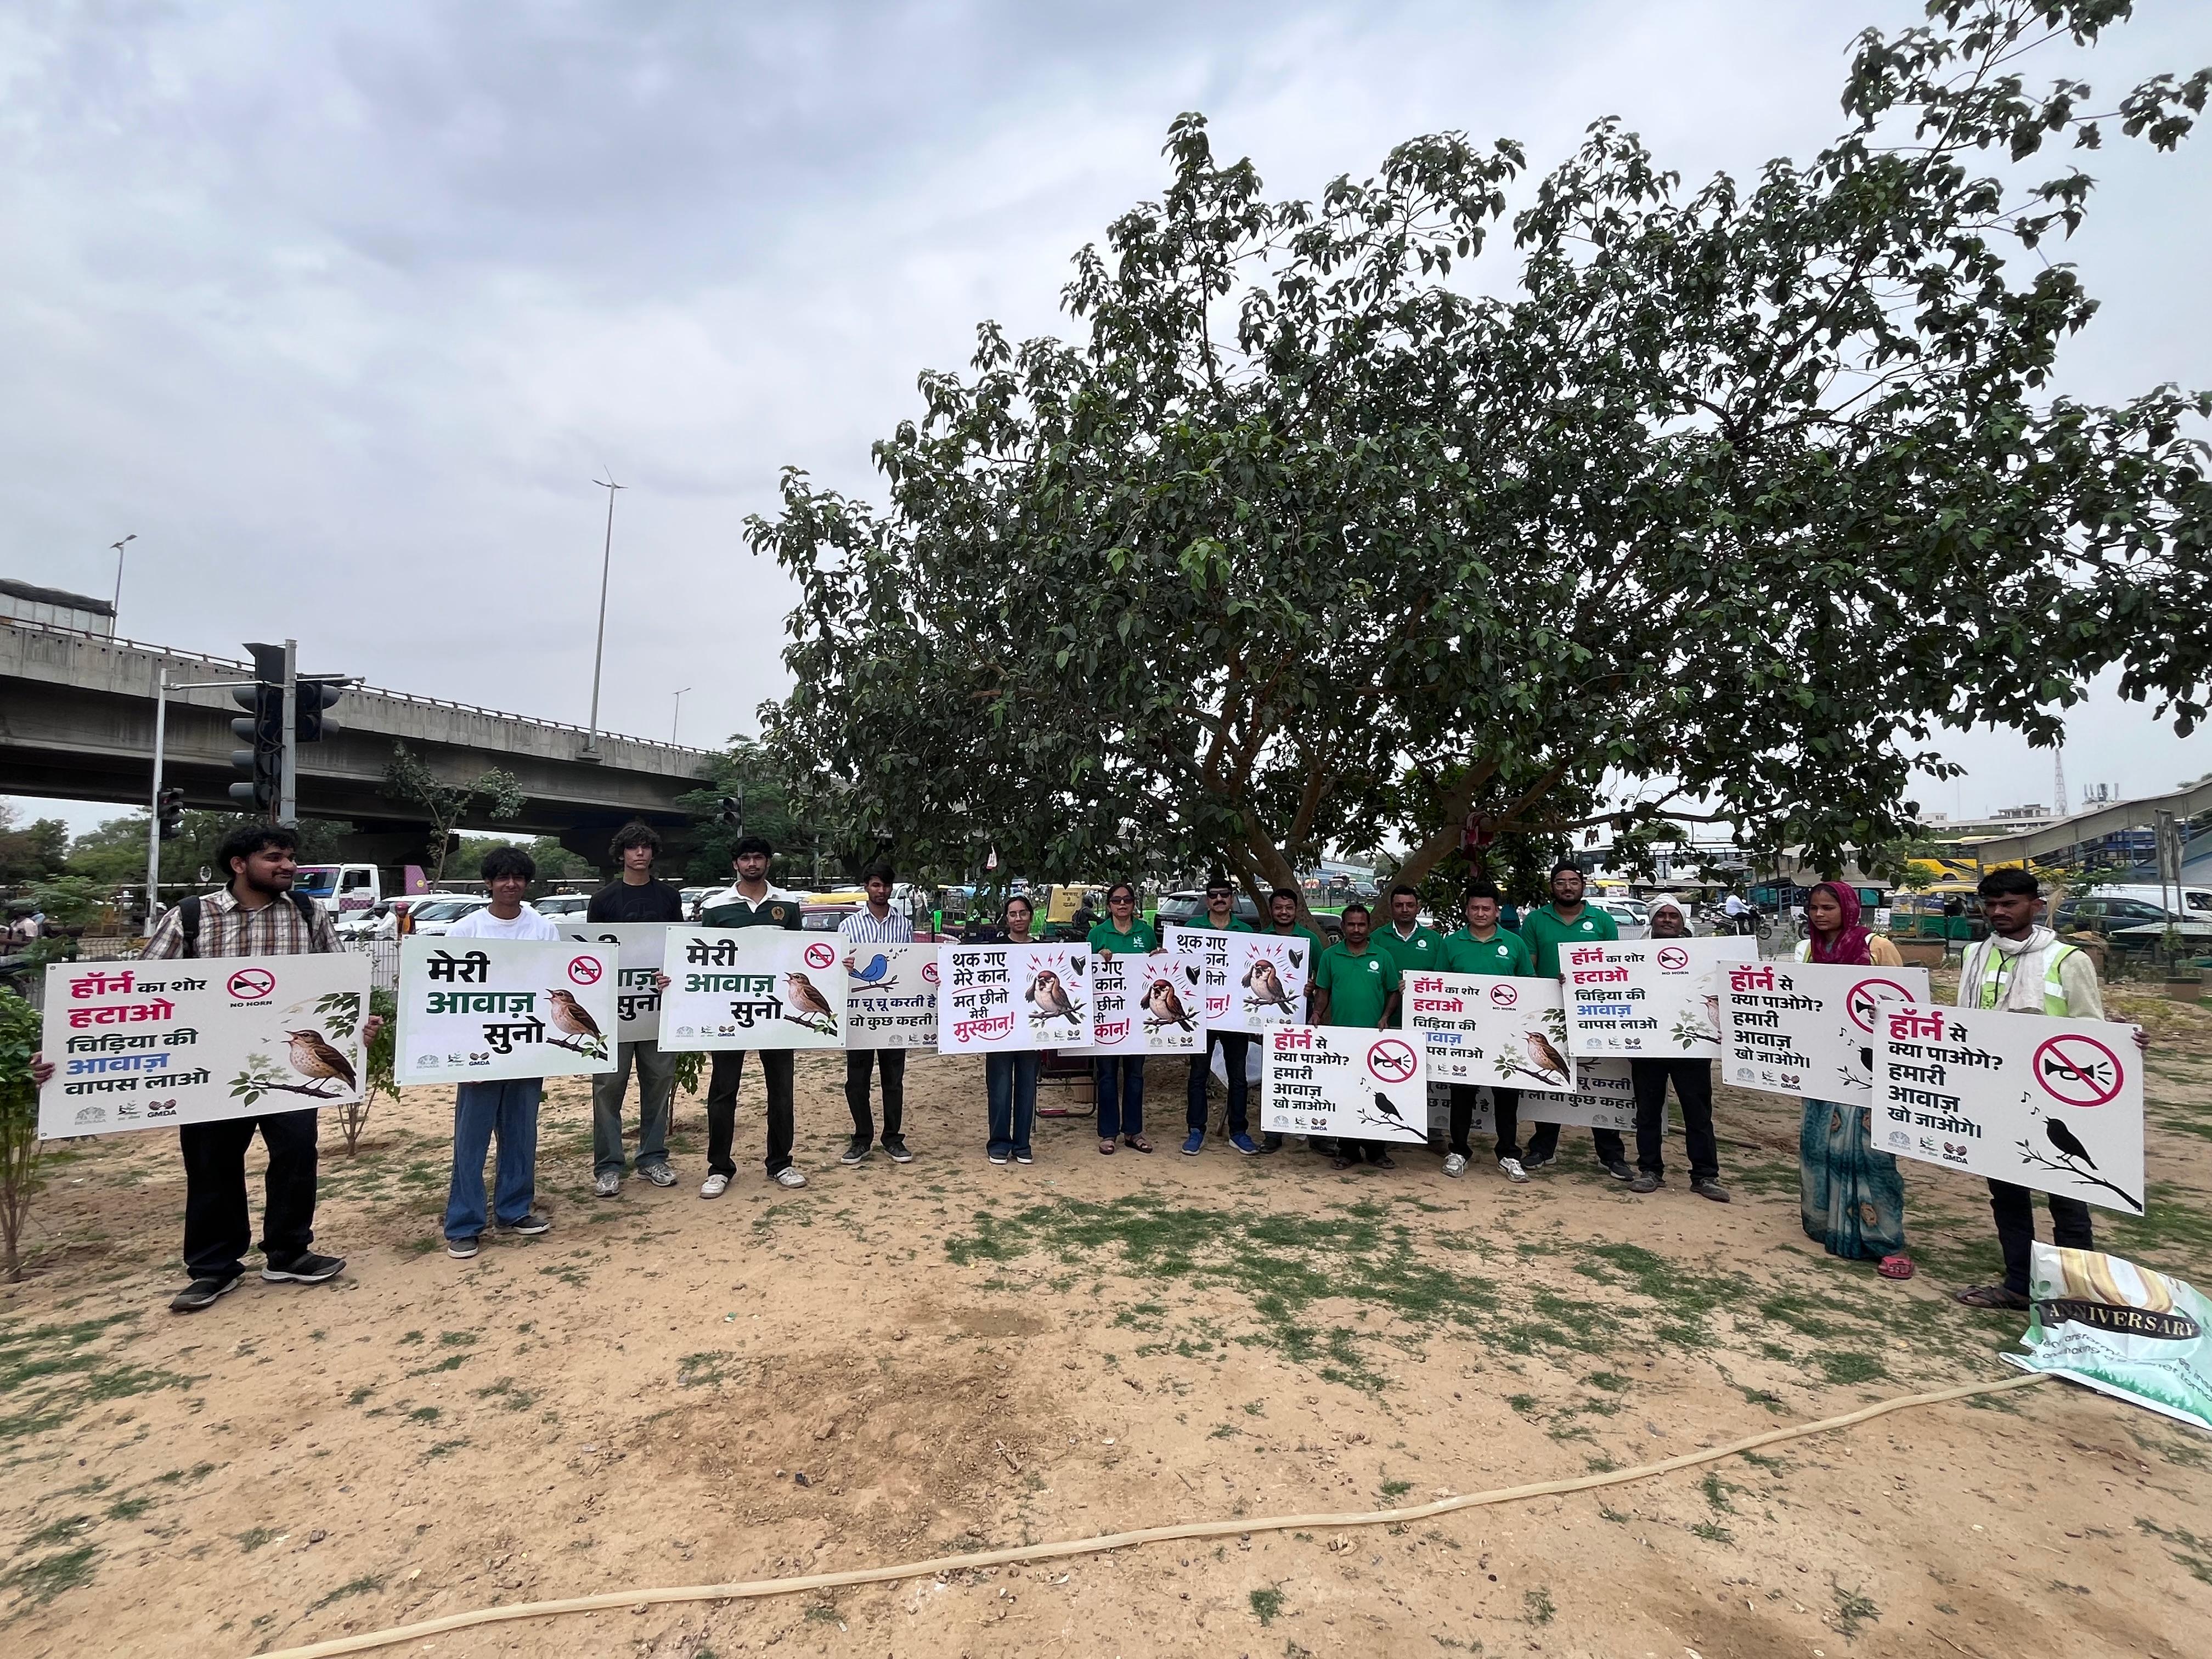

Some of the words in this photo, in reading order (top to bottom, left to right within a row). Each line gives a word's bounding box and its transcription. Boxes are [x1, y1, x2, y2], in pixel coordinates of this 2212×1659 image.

[686, 938, 738, 966] मेरी
[1177, 934, 1203, 949] थक
[1206, 937, 1228, 952] गए
[952, 952, 980, 968] थक
[984, 952, 1006, 967] गए
[1570, 947, 1604, 965] हॉर्न
[1624, 952, 1645, 962] शोर
[426, 950, 490, 983] मेरी
[1101, 961, 1124, 975] गए
[1572, 966, 1628, 984] हटाओ
[69, 970, 134, 999] हॉर्न
[137, 981, 166, 994] का
[172, 977, 207, 992] शोर
[685, 973, 776, 997] आवाज़
[953, 969, 974, 986] मेरे
[977, 969, 1010, 984] कान,
[1094, 978, 1126, 991] कान,
[1413, 977, 1443, 993] हॉर्न
[1462, 986, 1480, 995] शोर
[1729, 965, 1774, 991] हॉर्न
[1778, 975, 1793, 991] से
[426, 991, 536, 1018] आवाज़
[890, 995, 924, 1007] करती
[927, 994, 936, 1008] है
[953, 994, 975, 1008] मत
[980, 989, 1009, 1005] छीनो
[1097, 996, 1126, 1011] छीनो
[1413, 997, 1464, 1012] हटाओ
[1575, 989, 1622, 1003] चिड़िया
[1625, 988, 1645, 1000] की
[1731, 994, 1758, 1006] क्या
[1762, 994, 1823, 1012] पाओगे?
[68, 997, 175, 1029] हटाओ
[730, 995, 783, 1028] सुनो
[969, 1008, 988, 1019] मेरी
[1577, 1005, 1632, 1017] आवाज़
[1732, 1010, 1779, 1028] हमारी
[850, 1014, 865, 1026] वो
[867, 1017, 894, 1030] कुछ
[896, 1013, 932, 1026] कहती
[953, 1012, 1014, 1042] मुस्कान!
[1413, 1016, 1455, 1031] चिड़िया
[1458, 1019, 1476, 1031] की
[1578, 1020, 1616, 1029] वापस
[1620, 1017, 1658, 1029] लाओ
[1888, 1008, 1944, 1041] हॉर्न
[1949, 1023, 1967, 1042] से
[66, 1034, 157, 1054] चिड़िया
[162, 1027, 199, 1046] की
[482, 1016, 546, 1054] सुनो
[1273, 1028, 1312, 1050] हॉर्न
[1315, 1036, 1328, 1049] से
[1734, 1030, 1791, 1051] आवाज़
[1273, 1052, 1297, 1062] क्या
[1300, 1052, 1349, 1065] पाओगे?
[1449, 1047, 1483, 1059] लाओ
[1734, 1046, 1754, 1060] खो
[1757, 1050, 1810, 1069] जाओगे।
[1888, 1041, 1921, 1058] क्या
[1927, 1043, 2003, 1070] पाओगे?
[67, 1053, 170, 1074] आवाज़
[1273, 1065, 1313, 1079] हमारी
[64, 1075, 138, 1096] वापस
[144, 1068, 211, 1090] लाओ
[1888, 1062, 1945, 1086] हमारी
[1273, 1083, 1322, 1099] आवाज़
[1592, 1077, 1630, 1091] करती
[1273, 1097, 1289, 1109] खो
[1291, 1099, 1335, 1112] जाओगे।
[1568, 1094, 1597, 1107] कुछ
[1888, 1086, 1960, 1114] आवाज़
[1888, 1106, 1910, 1123] खो
[1915, 1113, 1982, 1139] जाओगे।
[1943, 1153, 1968, 1164] GMDA
